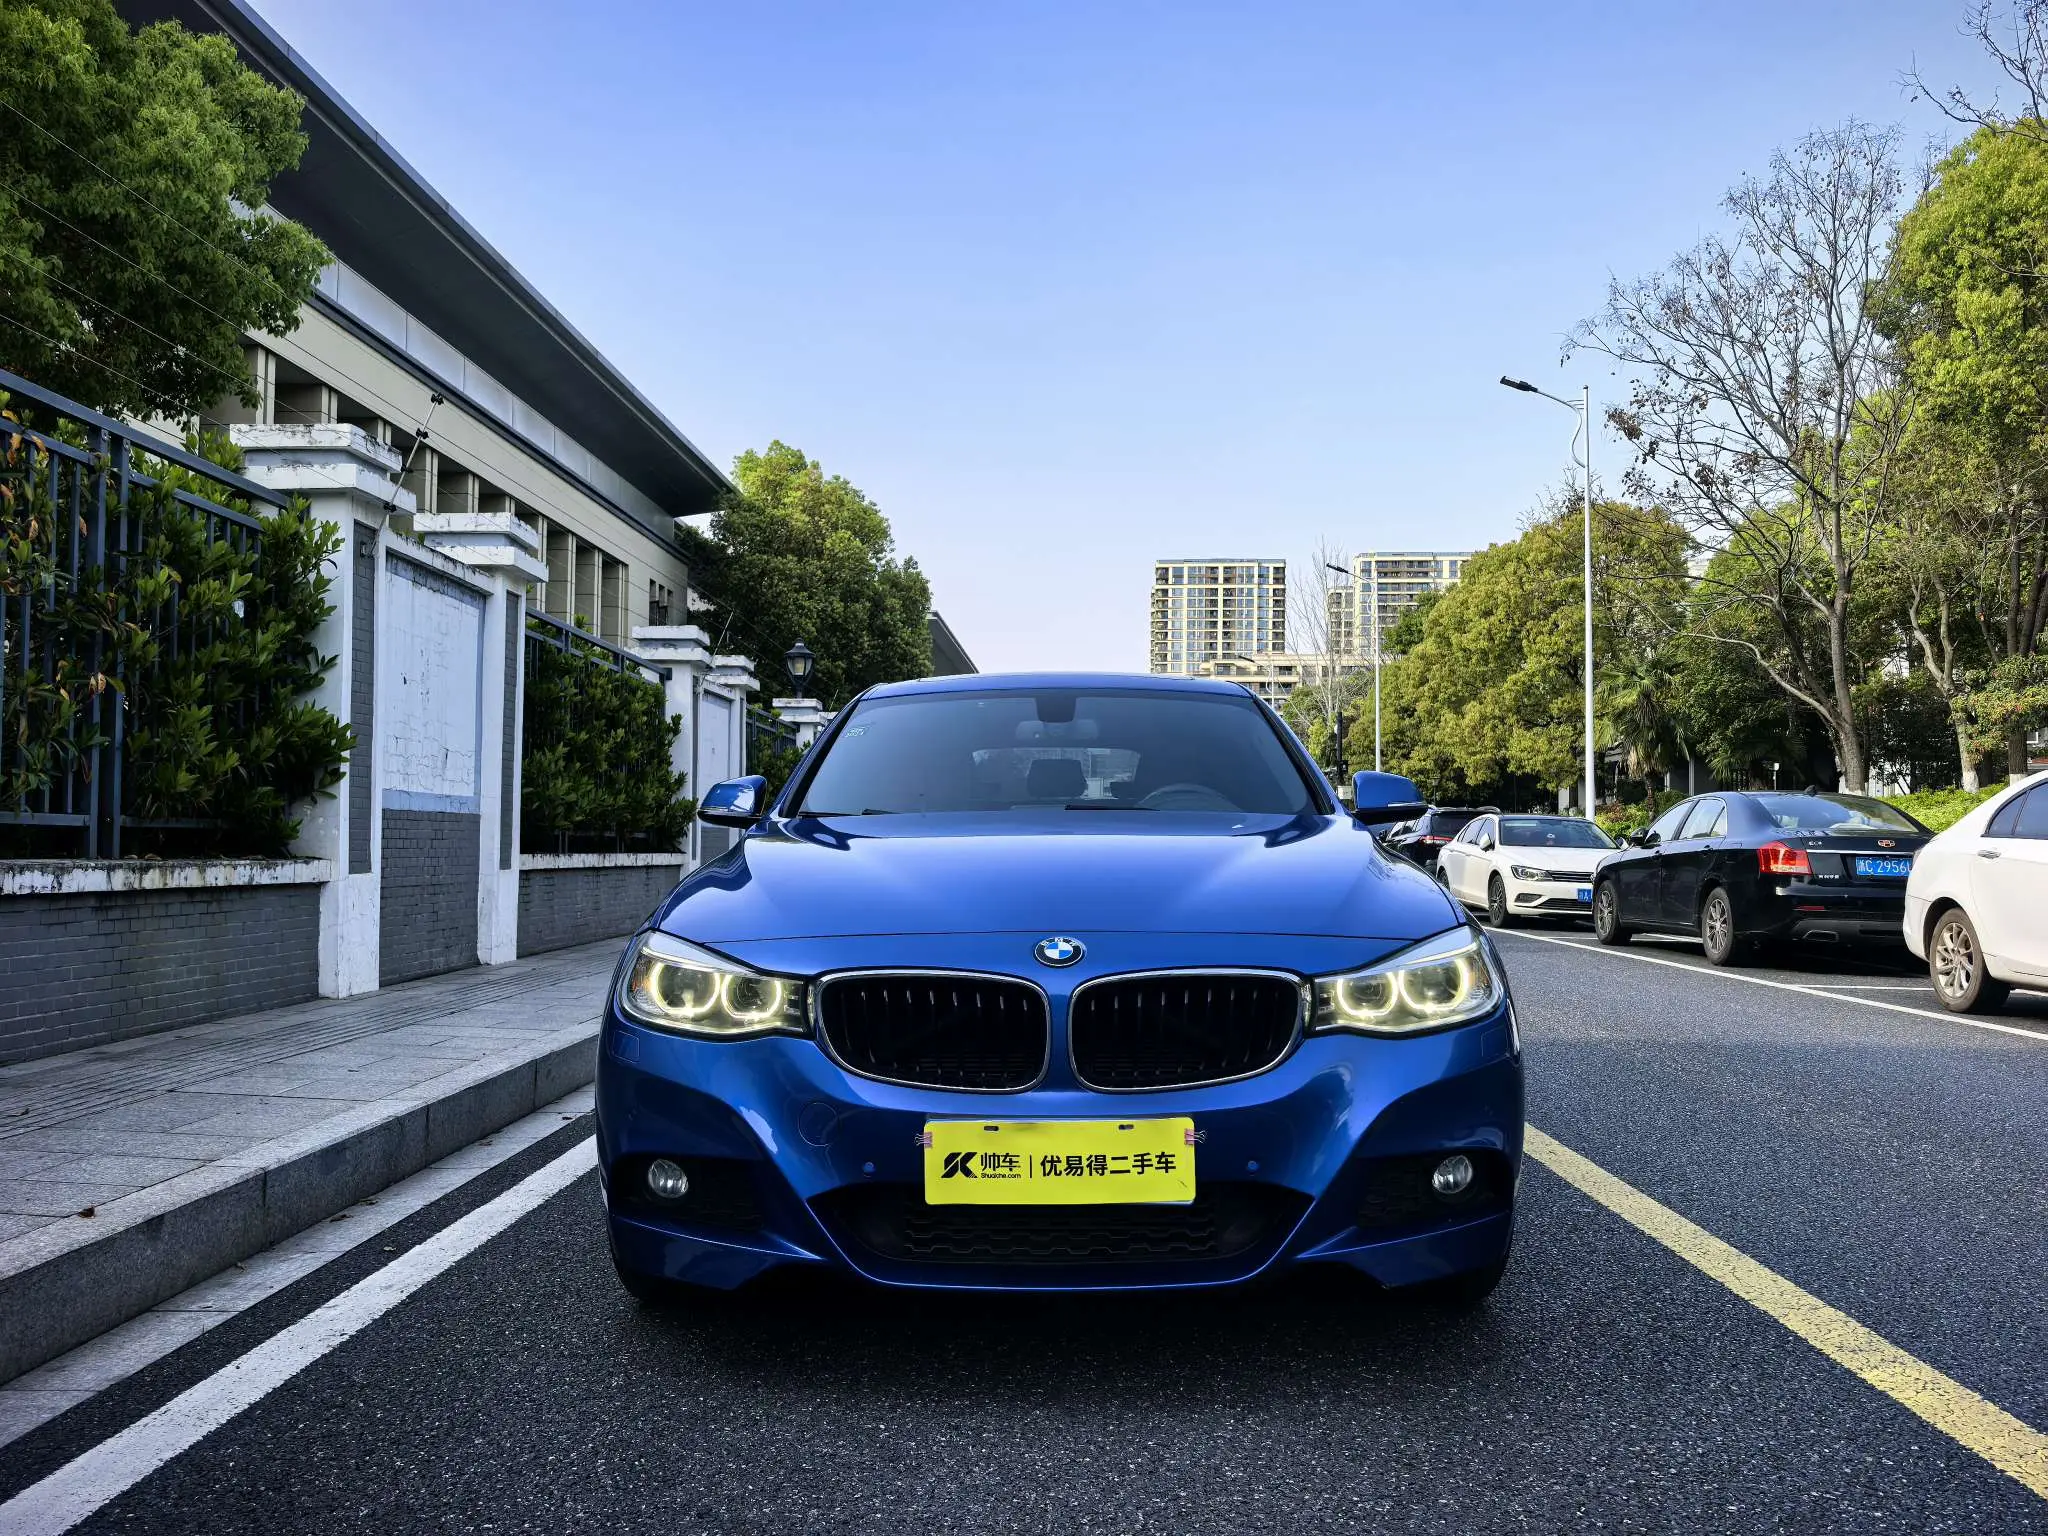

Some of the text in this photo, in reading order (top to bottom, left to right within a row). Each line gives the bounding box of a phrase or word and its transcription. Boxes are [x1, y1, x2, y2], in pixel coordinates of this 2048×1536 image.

[980, 1152, 1021, 1171] 帅车
[1040, 1151, 1176, 1177] 优易得二手车
